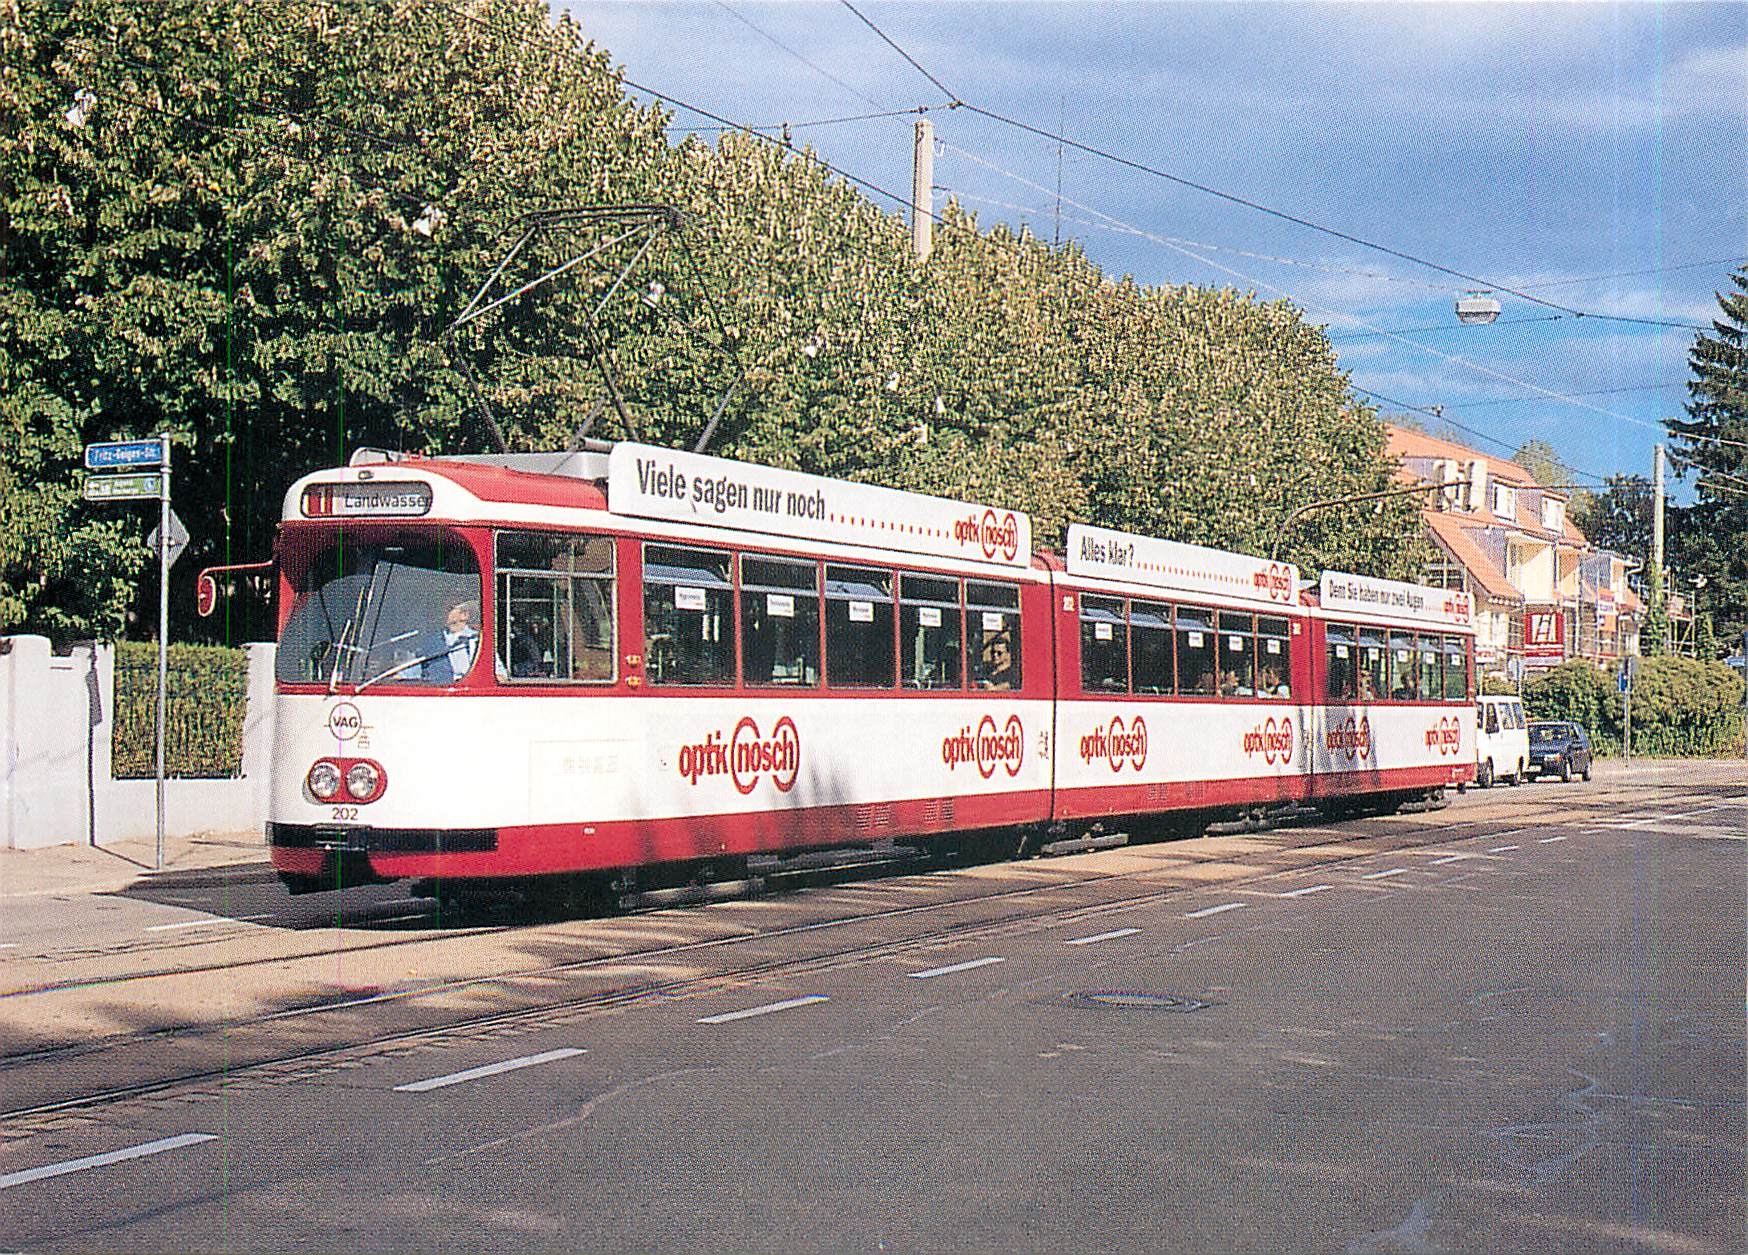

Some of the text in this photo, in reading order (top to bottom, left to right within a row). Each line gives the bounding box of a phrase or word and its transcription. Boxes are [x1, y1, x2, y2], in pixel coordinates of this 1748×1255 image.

[636, 458, 825, 520] Viele sagen nur noch
[954, 514, 980, 547] optik
[1080, 535, 1134, 568] Alles klar?
[333, 716, 358, 728] VAG
[679, 730, 729, 785] optik
[942, 725, 975, 771] optik
[1080, 725, 1107, 765] optik
[1243, 724, 1263, 758] optik
[332, 807, 359, 821] 202
